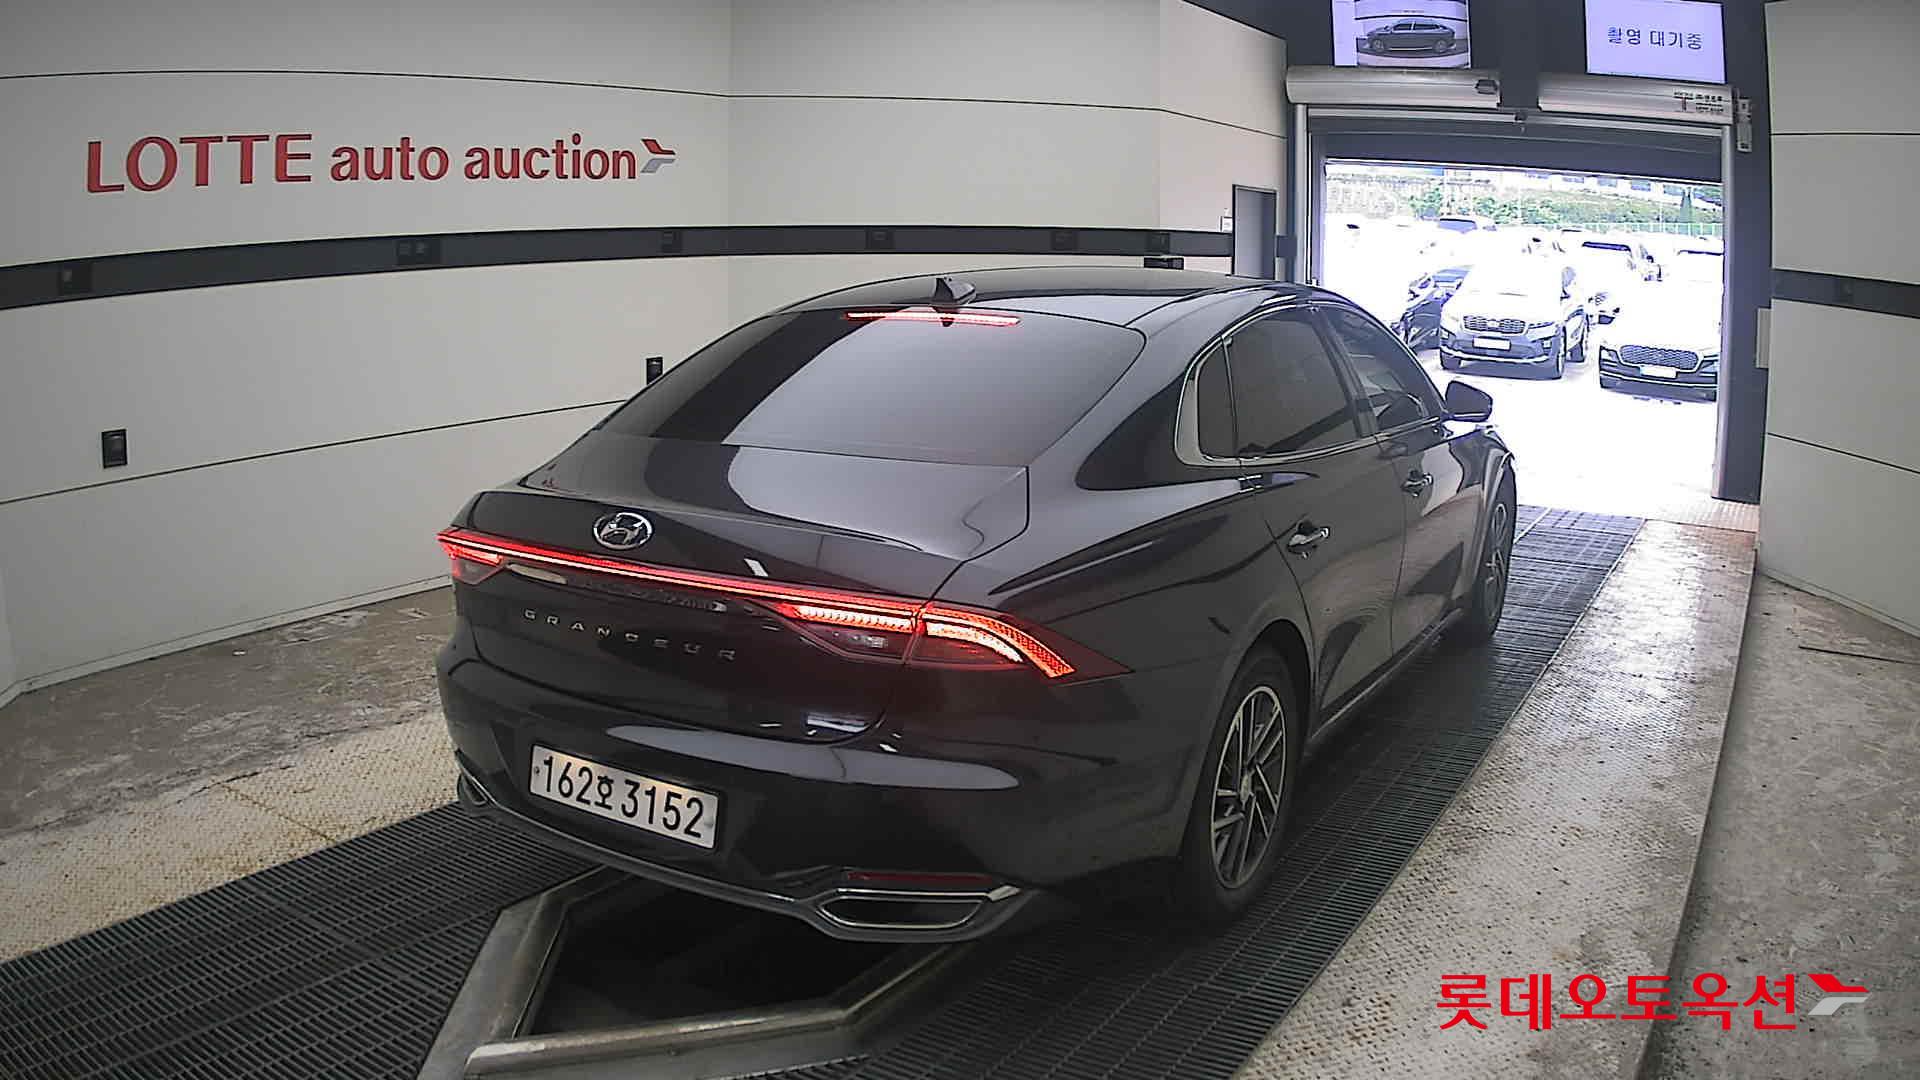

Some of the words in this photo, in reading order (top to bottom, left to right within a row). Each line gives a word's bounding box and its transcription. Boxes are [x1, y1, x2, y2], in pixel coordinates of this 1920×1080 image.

[1608, 26, 1641, 46] 촬영
[1650, 31, 1702, 50] 대기중
[86, 133, 312, 193] LOTTE
[330, 136, 449, 182] auto
[463, 133, 637, 181] auction
[524, 608, 736, 661] GRANDEUR
[621, 779, 705, 838] 3152
